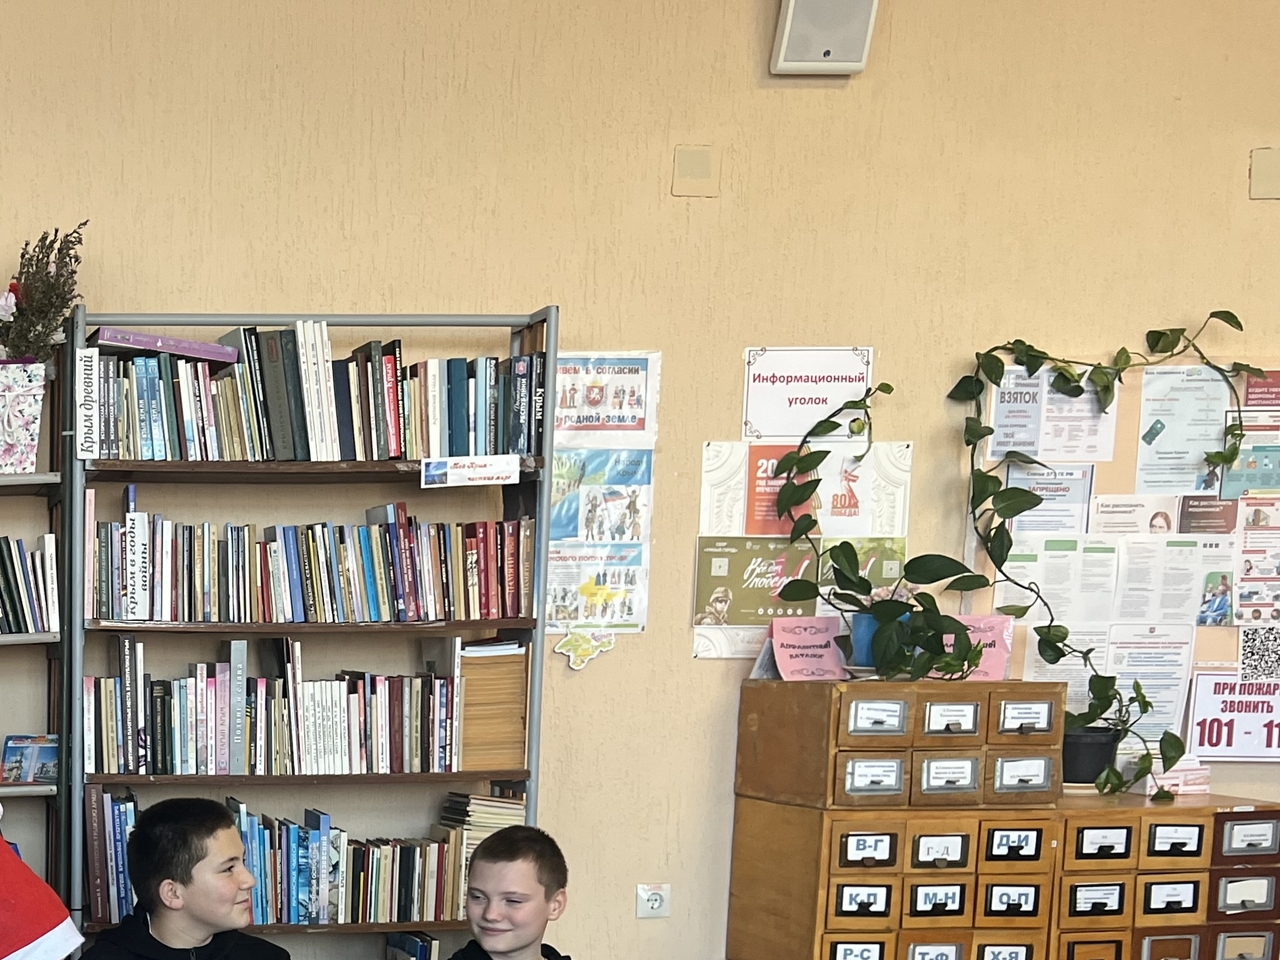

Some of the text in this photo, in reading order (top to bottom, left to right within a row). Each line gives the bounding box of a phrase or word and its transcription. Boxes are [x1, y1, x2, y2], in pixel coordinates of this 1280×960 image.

[556, 366, 581, 375] ивём
[596, 366, 640, 375] согласии
[751, 371, 866, 388] Информационный
[78, 354, 97, 454] Крым древний
[518, 377, 528, 424] РЕСПУБЛИКИ
[533, 387, 545, 420] Крым
[786, 394, 829, 408] уголок
[999, 391, 1039, 404] ВЗЯТОК
[563, 412, 637, 426] родной земле
[831, 493, 849, 508] 80
[1099, 502, 1146, 512] Как распознать
[127, 516, 139, 616] Крым в годы
[138, 542, 149, 592] войны
[505, 556, 515, 593] ПАМЯТИ
[1213, 682, 1280, 696] ПРИ ПОЖАР
[233, 662, 244, 743] Подвиг и слава
[1220, 700, 1274, 714] ЗВОНИТЬ
[219, 706, 227, 756] СТАРЫЙ КРЫМ
[1196, 717, 1235, 748] 101
[854, 838, 885, 852] В-Г
[996, 834, 1030, 850] Д-И
[923, 891, 957, 906] М-Н
